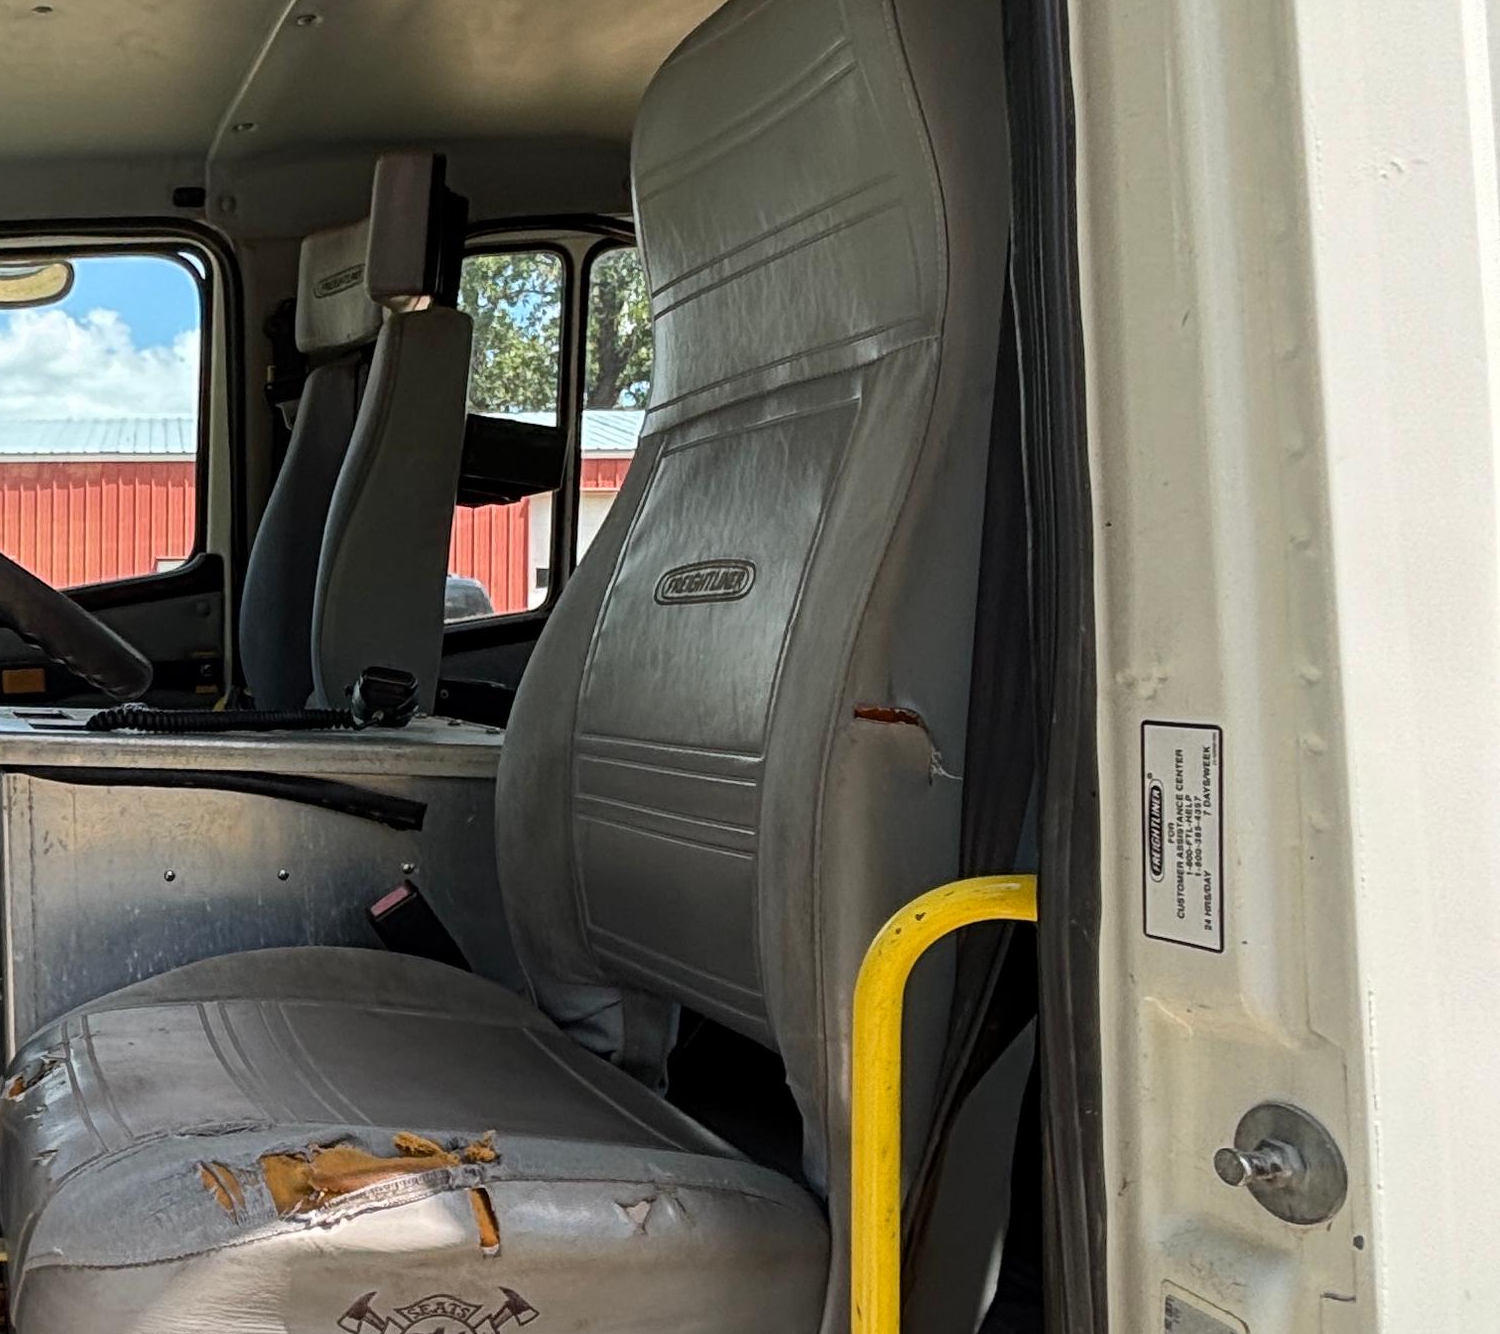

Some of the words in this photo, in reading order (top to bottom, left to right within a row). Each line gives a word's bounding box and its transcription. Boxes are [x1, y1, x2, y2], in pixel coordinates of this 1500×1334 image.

[1175, 749, 1183, 792] CENTER
[1202, 746, 1212, 809] DAYS/WEEK
[1150, 787, 1162, 874] FREIGHTLINER
[1167, 822, 1175, 844] FOR
[1176, 794, 1184, 860] ASSISTANCE
[1185, 794, 1193, 876] 1-800-FTL-HELP
[1176, 861, 1185, 919] CUSTOMER
[1203, 870, 1213, 918] HRS/DAY
[1204, 919, 1213, 931] 24
[407, 1301, 471, 1318] SEATS
